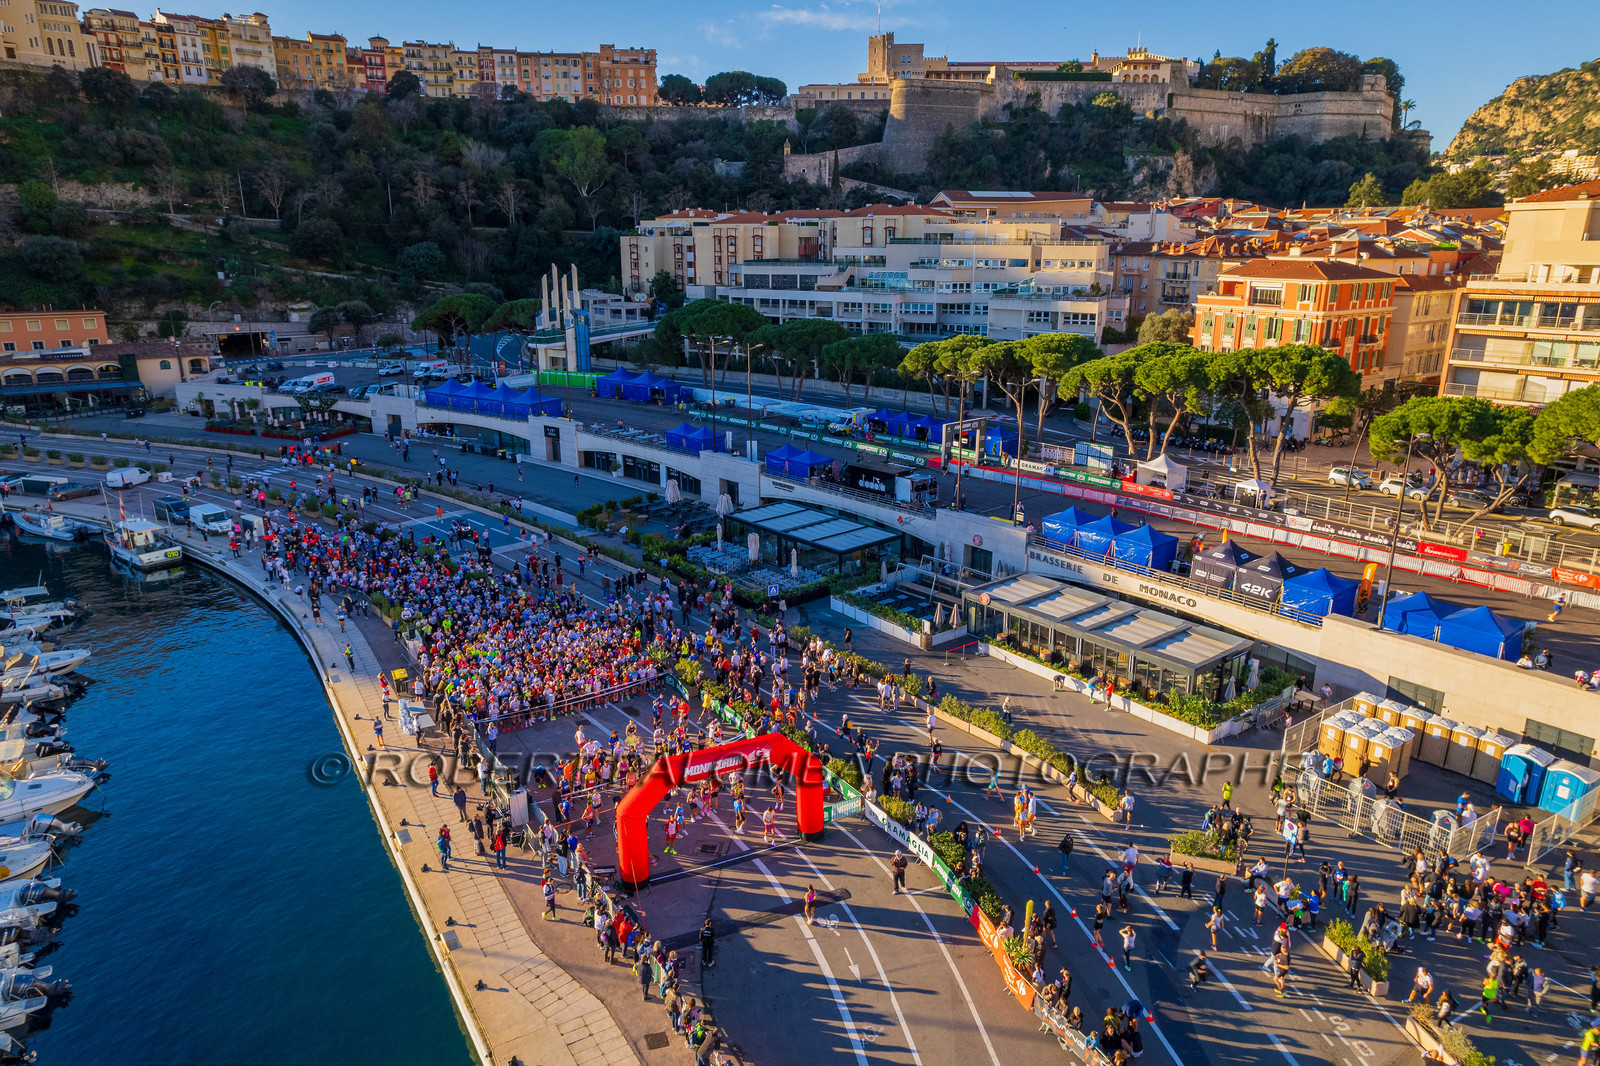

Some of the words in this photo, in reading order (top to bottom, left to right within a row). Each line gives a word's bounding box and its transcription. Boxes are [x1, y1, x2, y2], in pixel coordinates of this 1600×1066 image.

[1029, 550, 1084, 574] BRASSERIE
[1102, 572, 1119, 585] DE
[1138, 583, 1197, 608] MONACO
[1240, 582, 1273, 598] 42K
[881, 817, 929, 860] GRAMAGLIA
